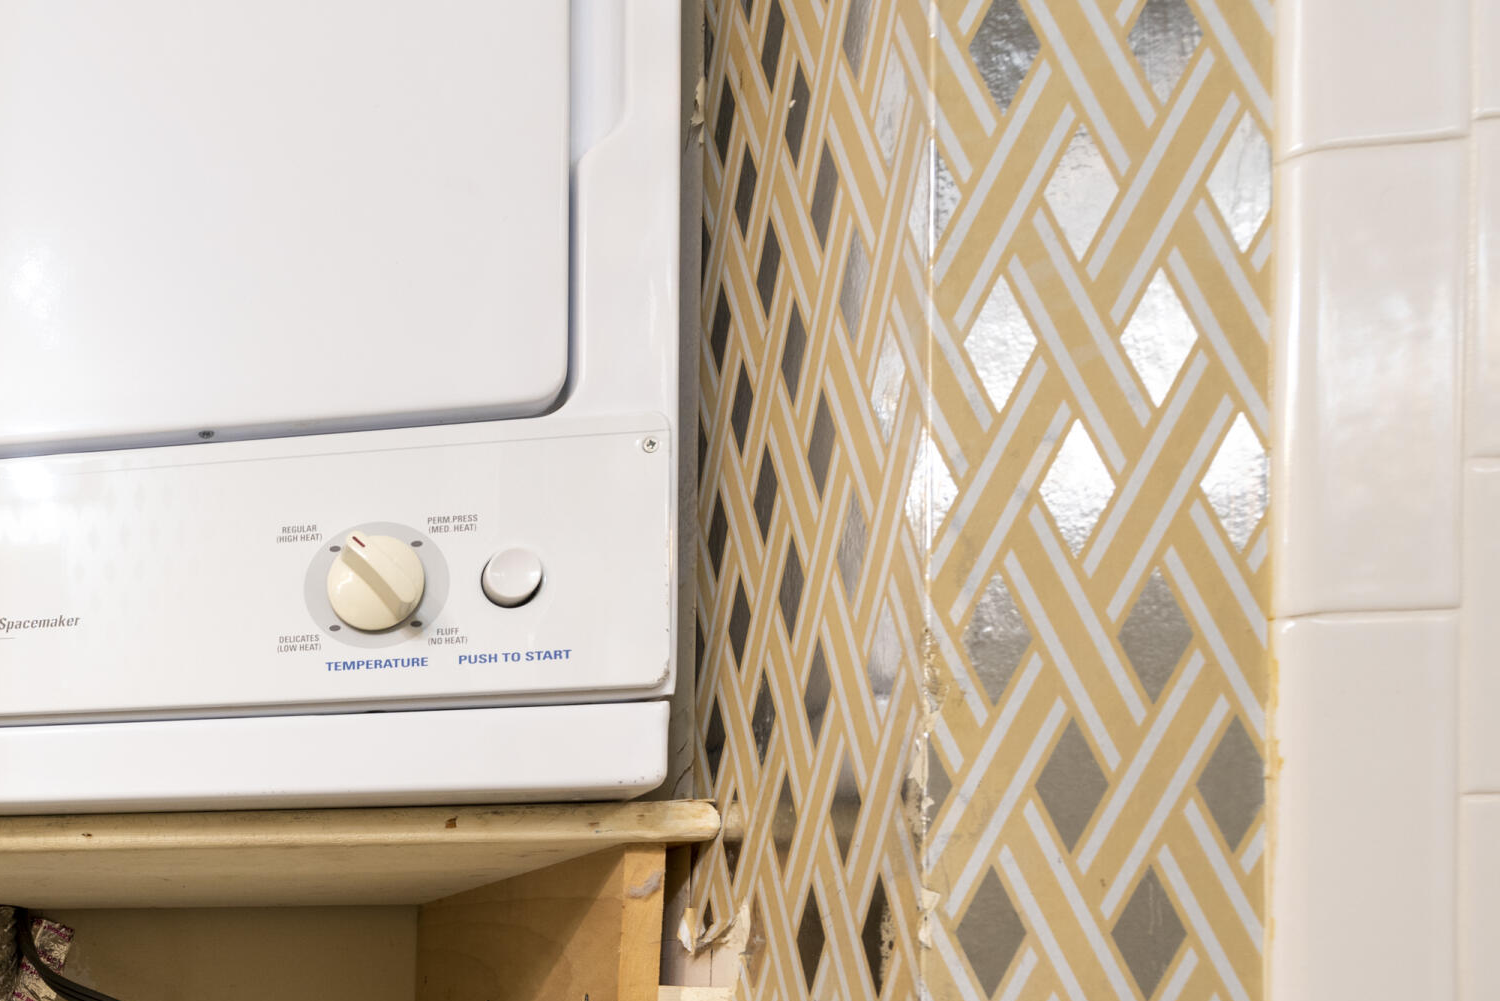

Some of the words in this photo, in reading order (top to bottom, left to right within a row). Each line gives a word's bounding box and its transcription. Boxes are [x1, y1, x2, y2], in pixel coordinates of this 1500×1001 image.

[282, 525, 317, 534] REGULAR
[429, 526, 451, 534] (MED.
[453, 524, 477, 532] HEAT)
[276, 535, 298, 544] (HIGH
[300, 533, 323, 542] HEAT)
[436, 628, 459, 636] FLUFF
[279, 634, 320, 643] DELICATES
[428, 637, 443, 646] (NO
[444, 636, 468, 645] HEAT)
[277, 644, 297, 654] (LOW
[299, 643, 322, 652] HEAT)
[458, 653, 498, 665] PUSH
[501, 651, 521, 663] TO
[525, 649, 572, 661] START
[325, 656, 429, 672] TEMPERATURE
